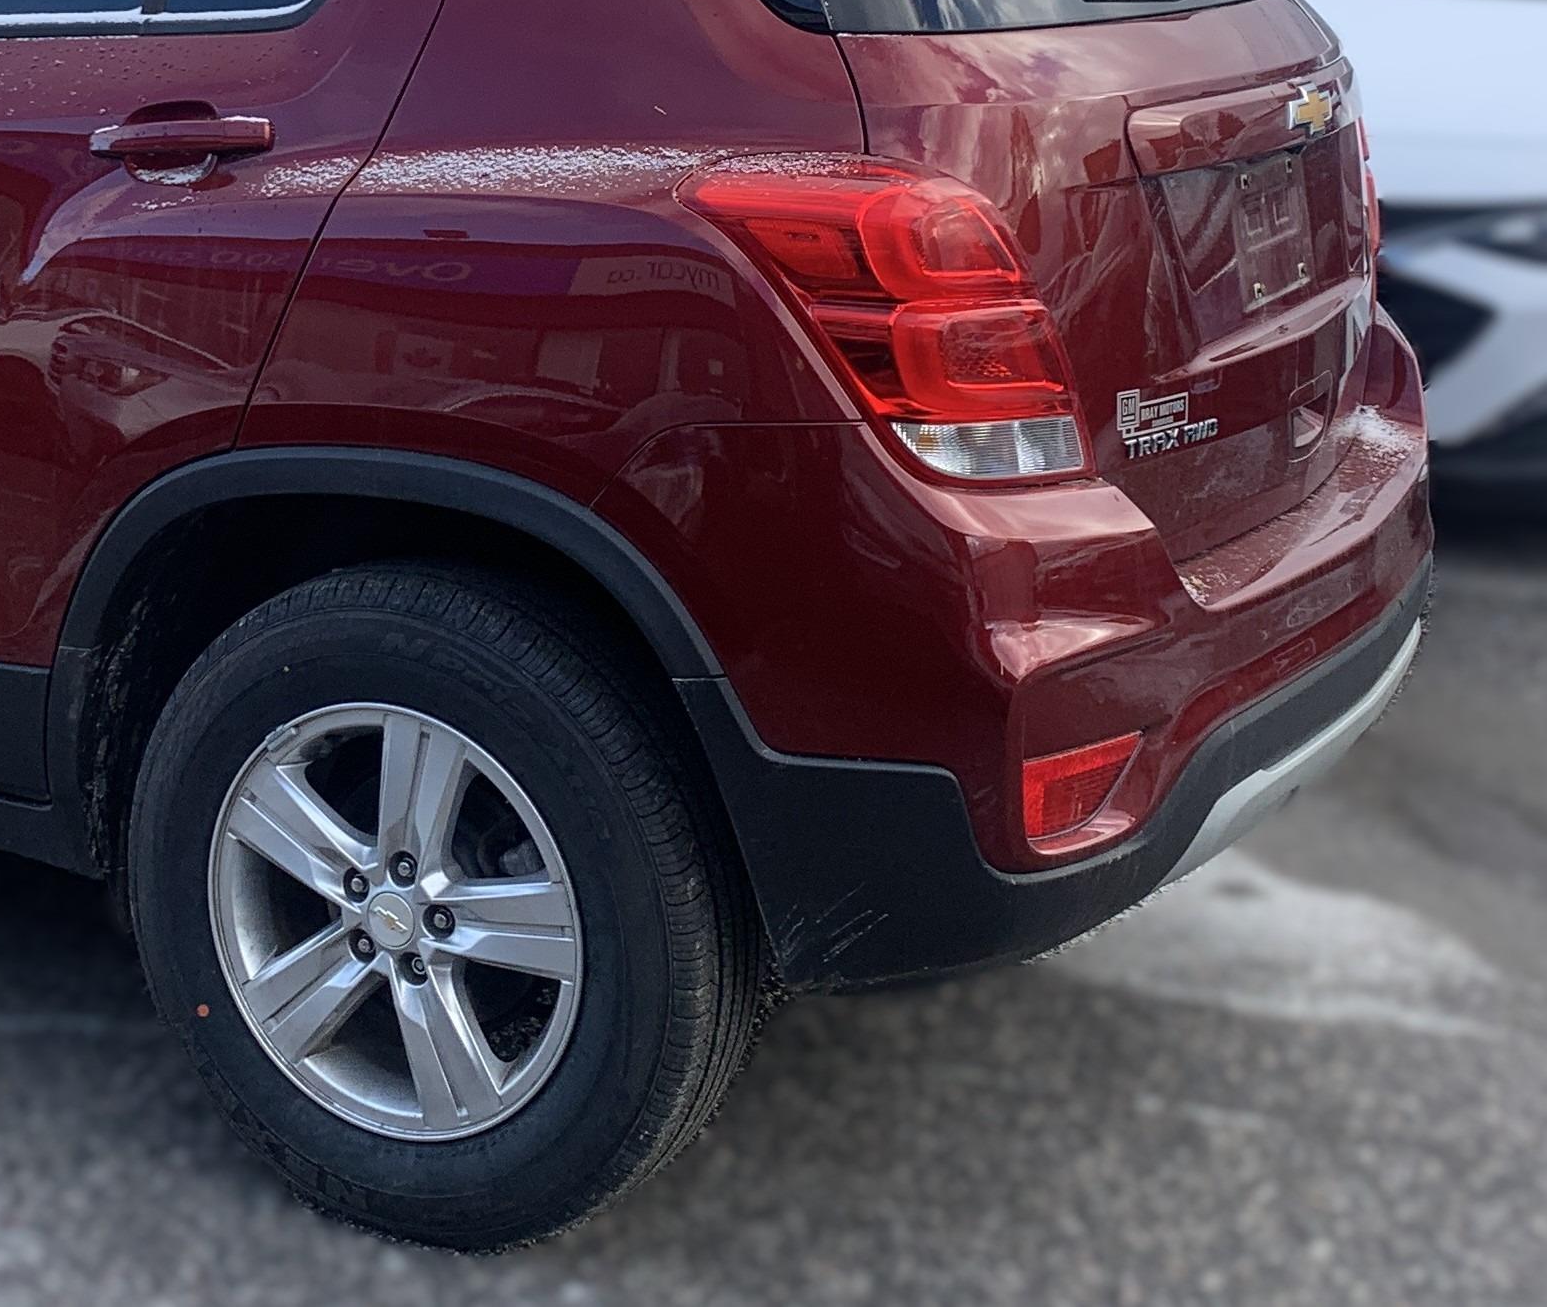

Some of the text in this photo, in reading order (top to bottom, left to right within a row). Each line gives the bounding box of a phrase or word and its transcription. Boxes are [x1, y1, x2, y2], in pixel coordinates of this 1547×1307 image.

[1122, 397, 1136, 417] GM
[1124, 417, 1219, 460] TRAX AWD
